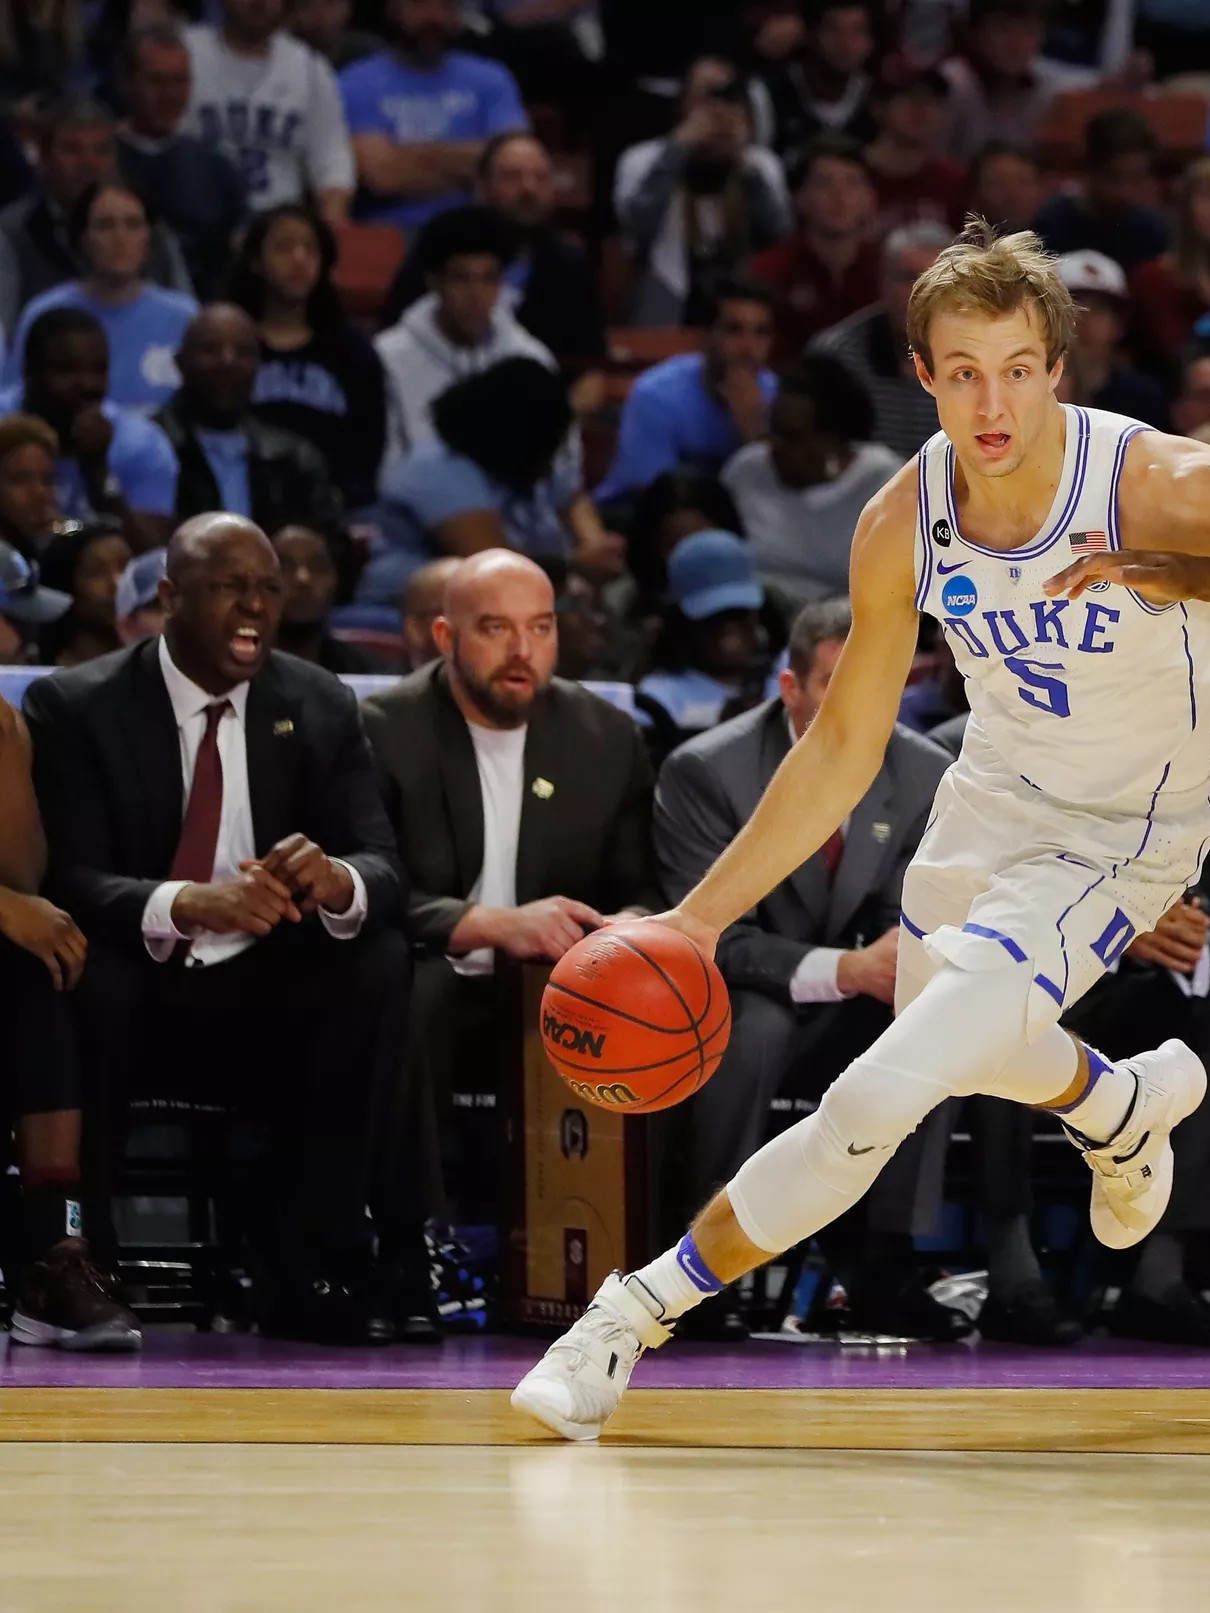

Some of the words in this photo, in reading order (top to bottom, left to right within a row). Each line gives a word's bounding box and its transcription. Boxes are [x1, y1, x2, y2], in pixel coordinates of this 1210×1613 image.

[936, 526, 950, 540] KB
[946, 593, 976, 607] NCAA
[943, 599, 1121, 658] DUKE
[1003, 656, 1071, 718] 5
